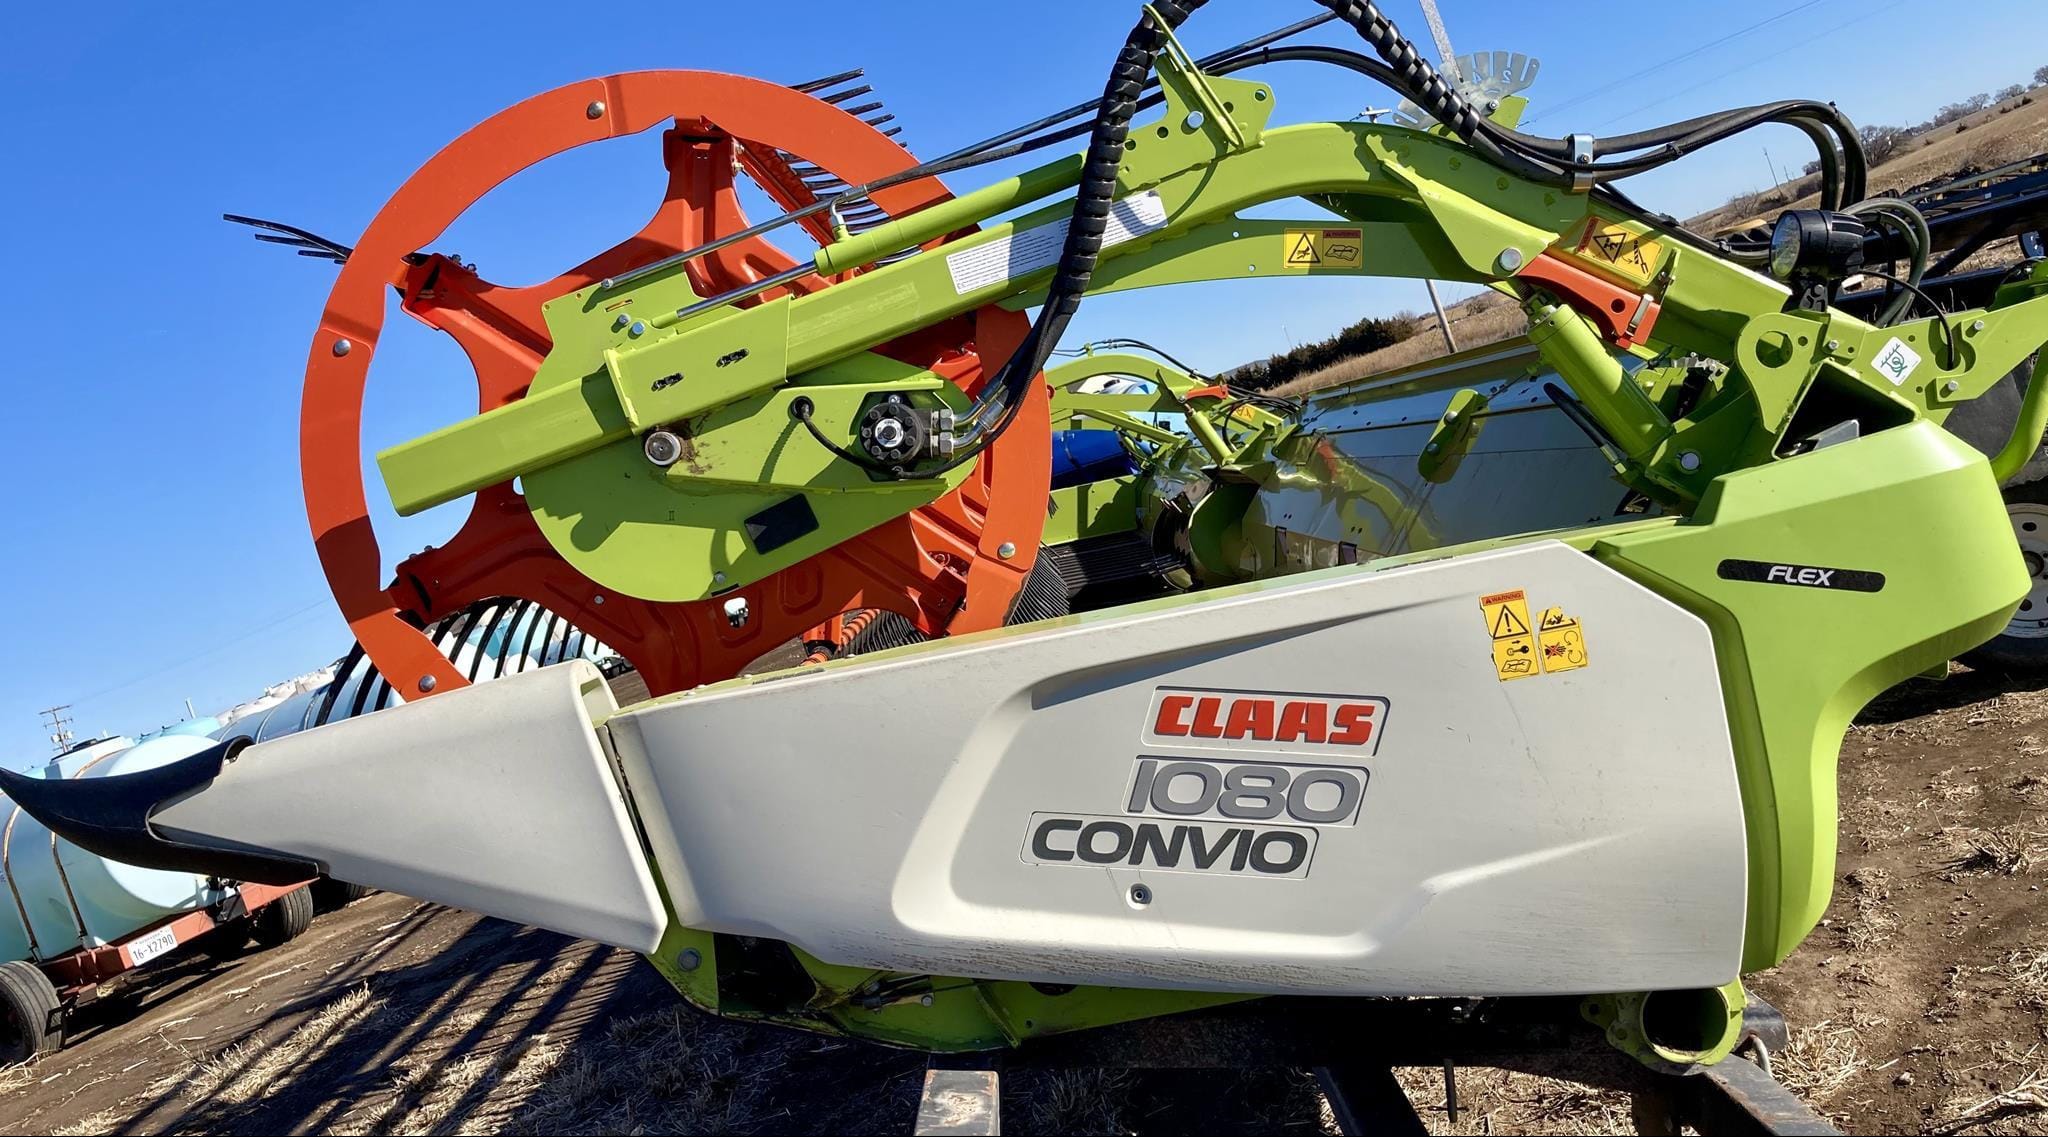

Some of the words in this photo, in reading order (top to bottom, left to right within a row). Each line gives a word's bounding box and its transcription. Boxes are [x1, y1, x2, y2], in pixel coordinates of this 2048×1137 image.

[1768, 566, 1834, 586] FLEX
[1492, 592, 1522, 603] WARNING
[1153, 695, 1375, 745] CLAAS
[1127, 760, 1361, 823] 1080
[1032, 818, 1308, 874] CONVIO
[133, 934, 174, 961] 16-X2790
